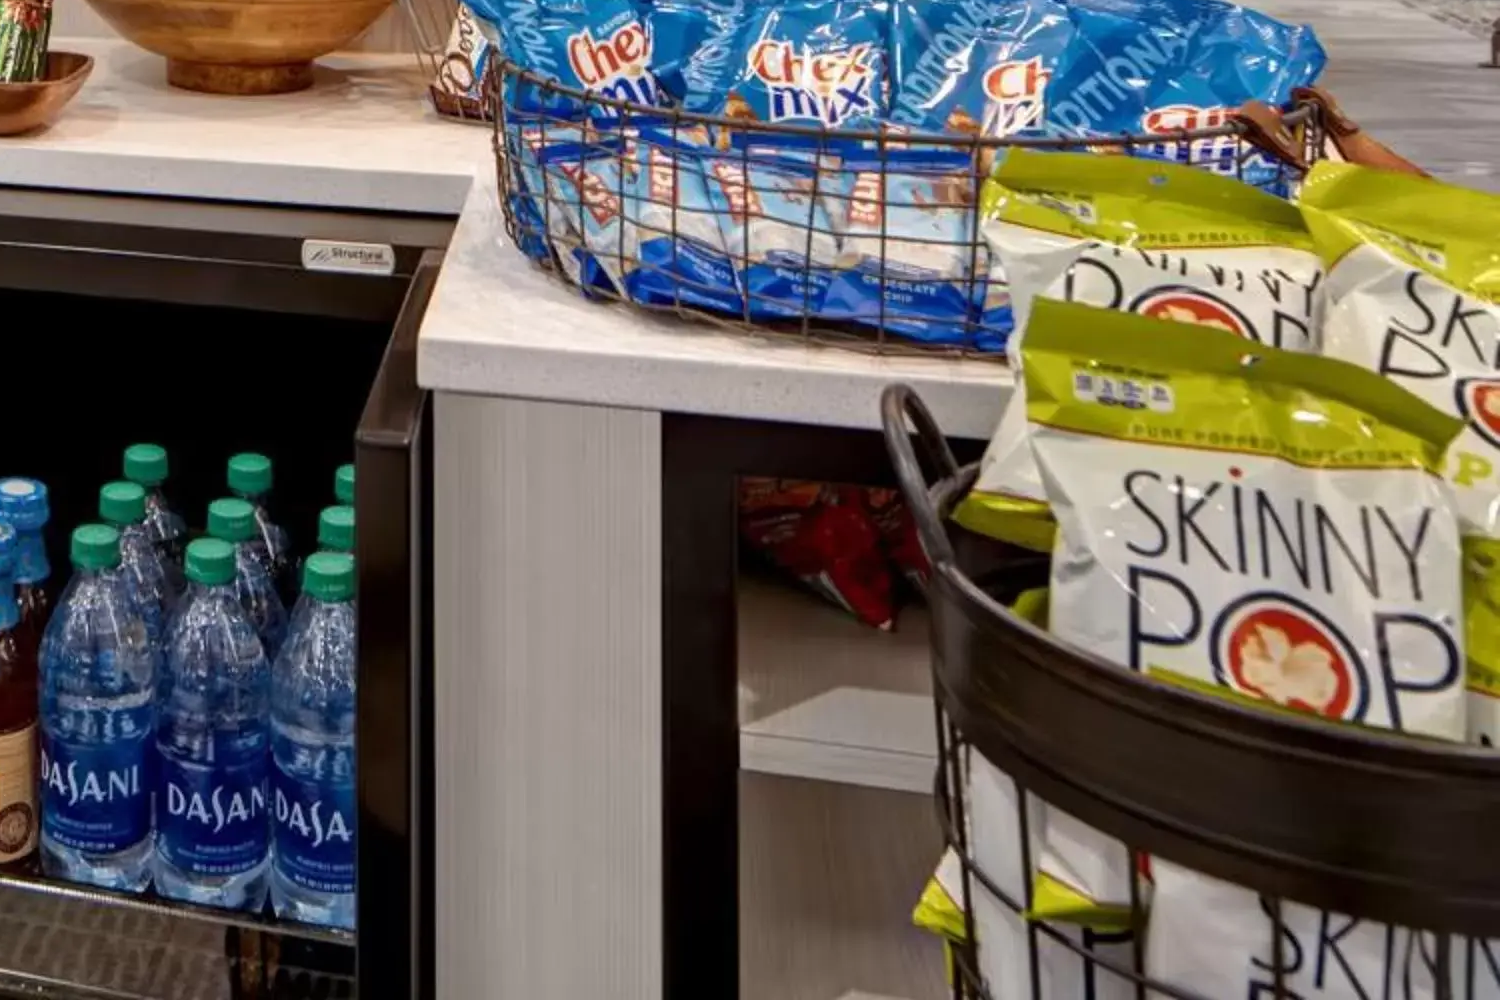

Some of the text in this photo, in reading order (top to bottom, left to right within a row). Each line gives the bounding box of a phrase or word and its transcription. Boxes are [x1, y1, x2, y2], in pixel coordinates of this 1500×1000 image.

[752, 40, 871, 82] Chex
[771, 78, 870, 125] mix
[1124, 467, 1434, 601] SKINNY
[1126, 563, 1461, 732] POP
[41, 748, 140, 806] DASANI
[167, 781, 266, 835] DASAN
[275, 787, 354, 848] DASA
